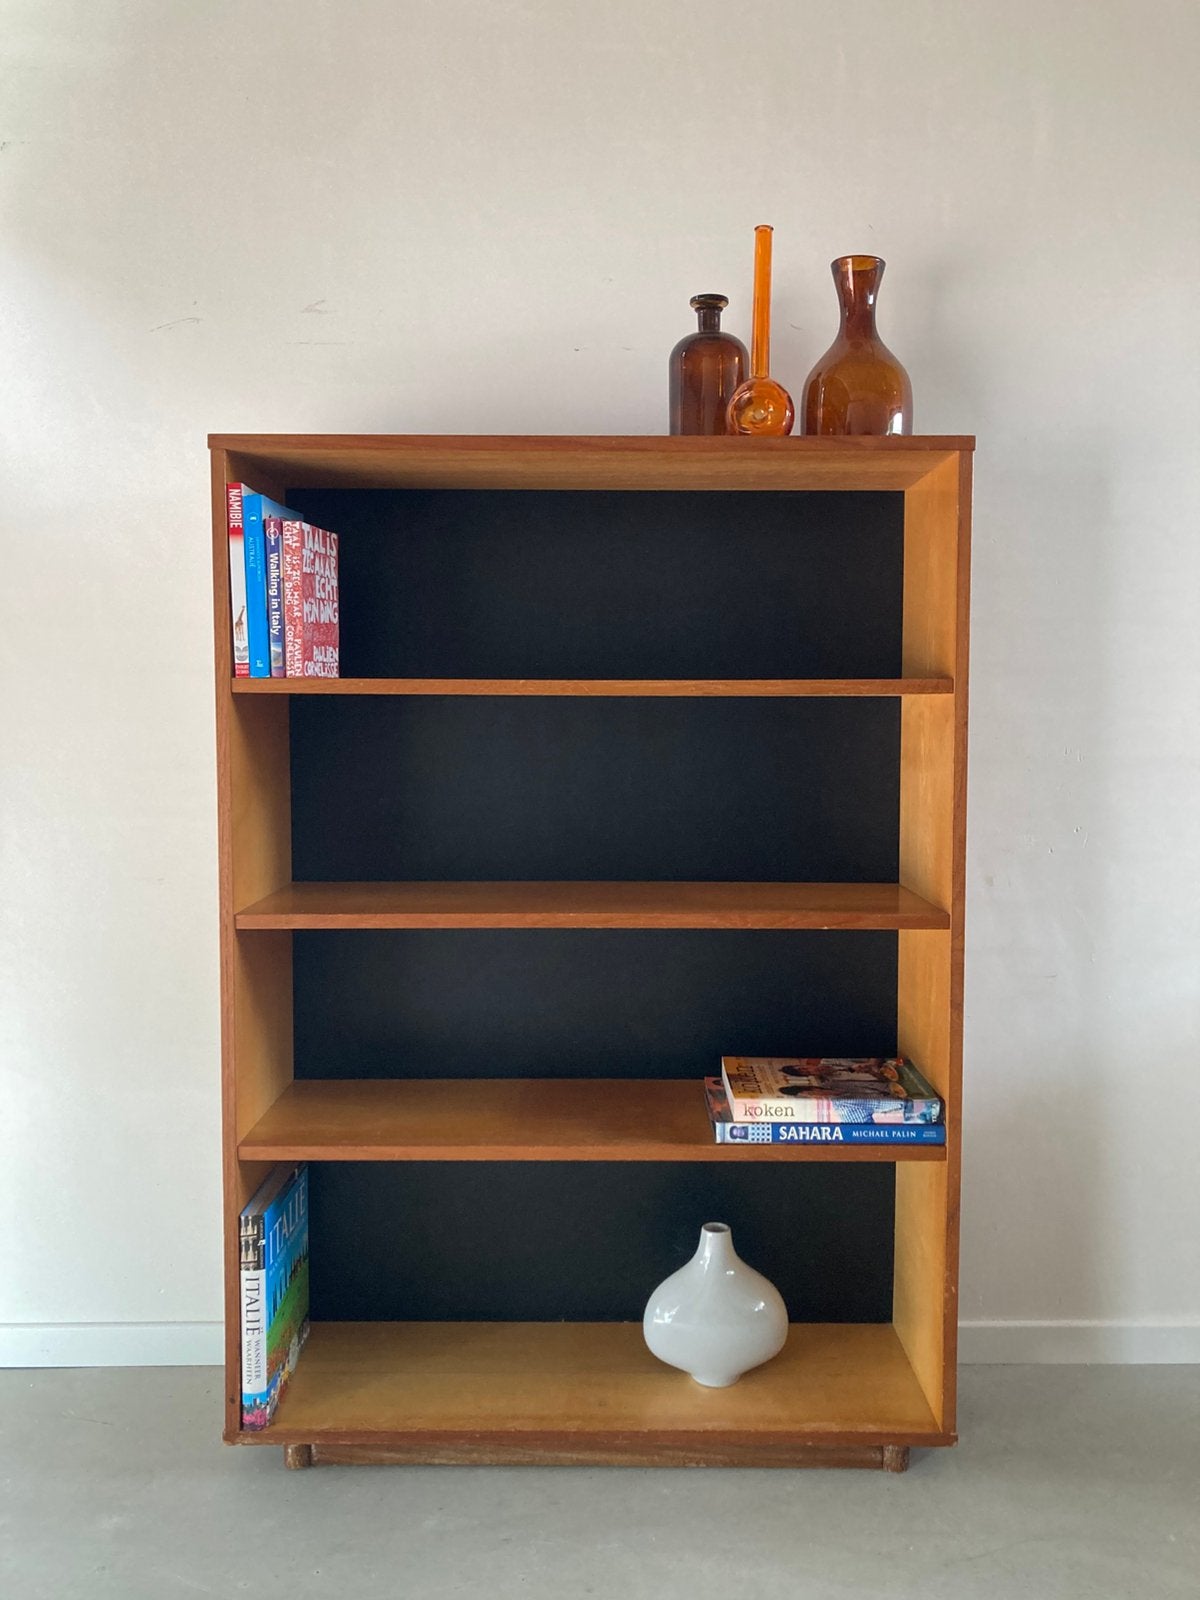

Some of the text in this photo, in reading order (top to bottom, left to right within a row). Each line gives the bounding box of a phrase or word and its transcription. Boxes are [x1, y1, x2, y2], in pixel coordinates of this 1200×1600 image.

[229, 488, 243, 529] NAMIBIE
[302, 522, 325, 552] TAAL
[269, 553, 281, 596] Walking
[315, 574, 338, 600] ECHT
[272, 598, 281, 608] in
[270, 611, 282, 635] Italy
[743, 1103, 795, 1117] koken
[778, 1125, 844, 1141] SAHARA
[852, 1130, 889, 1138] MICHAEL
[892, 1130, 917, 1138] PALIN
[245, 1277, 264, 1336] ITALIË
